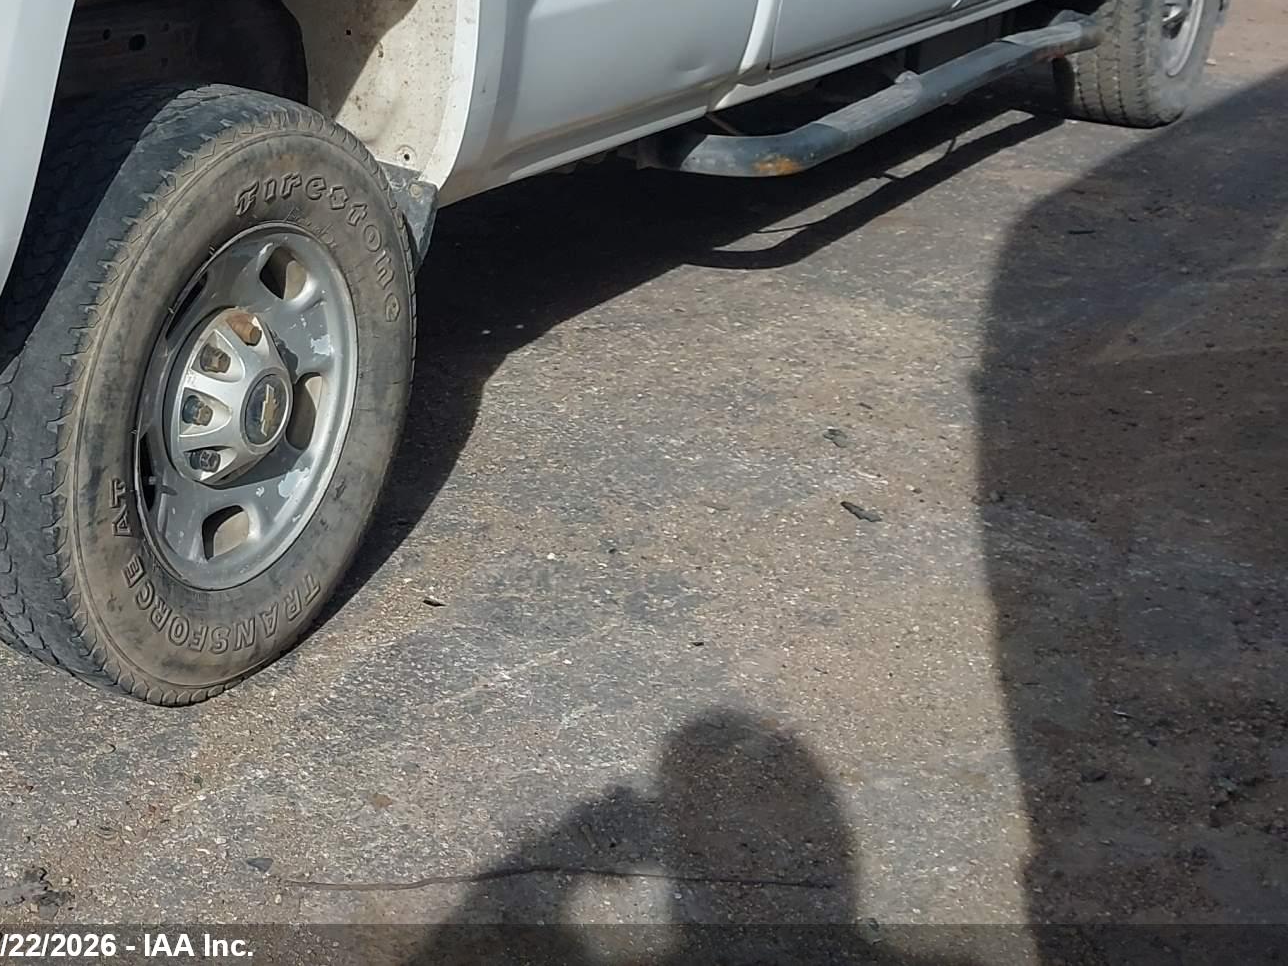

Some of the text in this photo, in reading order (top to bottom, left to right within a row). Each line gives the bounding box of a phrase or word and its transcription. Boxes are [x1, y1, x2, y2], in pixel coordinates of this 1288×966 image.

[233, 170, 401, 322] Firestone
[108, 477, 321, 655] TRANSFORCE AT
